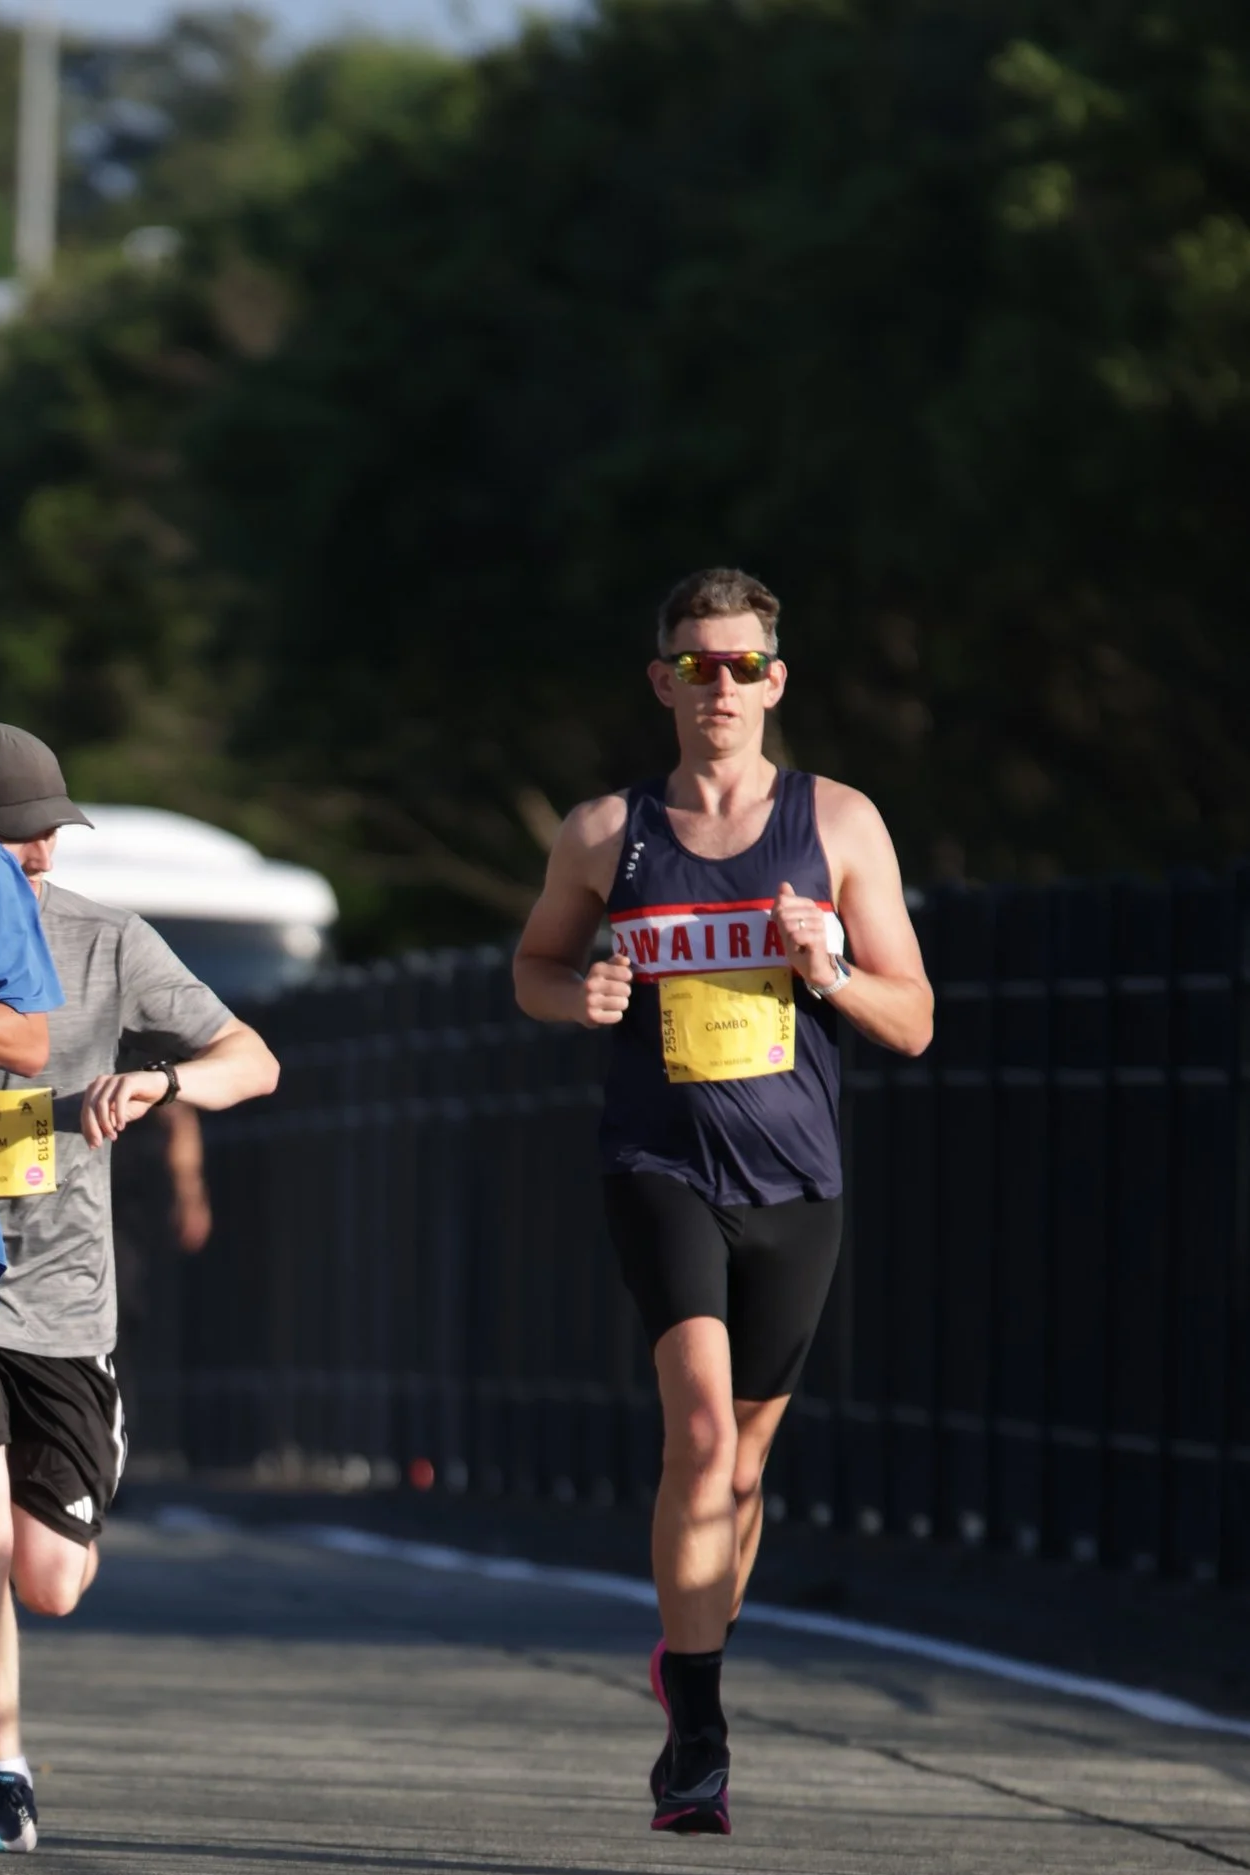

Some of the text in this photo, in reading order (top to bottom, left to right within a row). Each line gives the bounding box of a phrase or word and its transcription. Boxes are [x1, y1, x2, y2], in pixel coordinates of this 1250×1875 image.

[663, 1009, 677, 1054] 25544
[705, 1018, 749, 1032] CAMBO
[778, 997, 790, 1041] 25544
[36, 1119, 49, 1162] 23313
